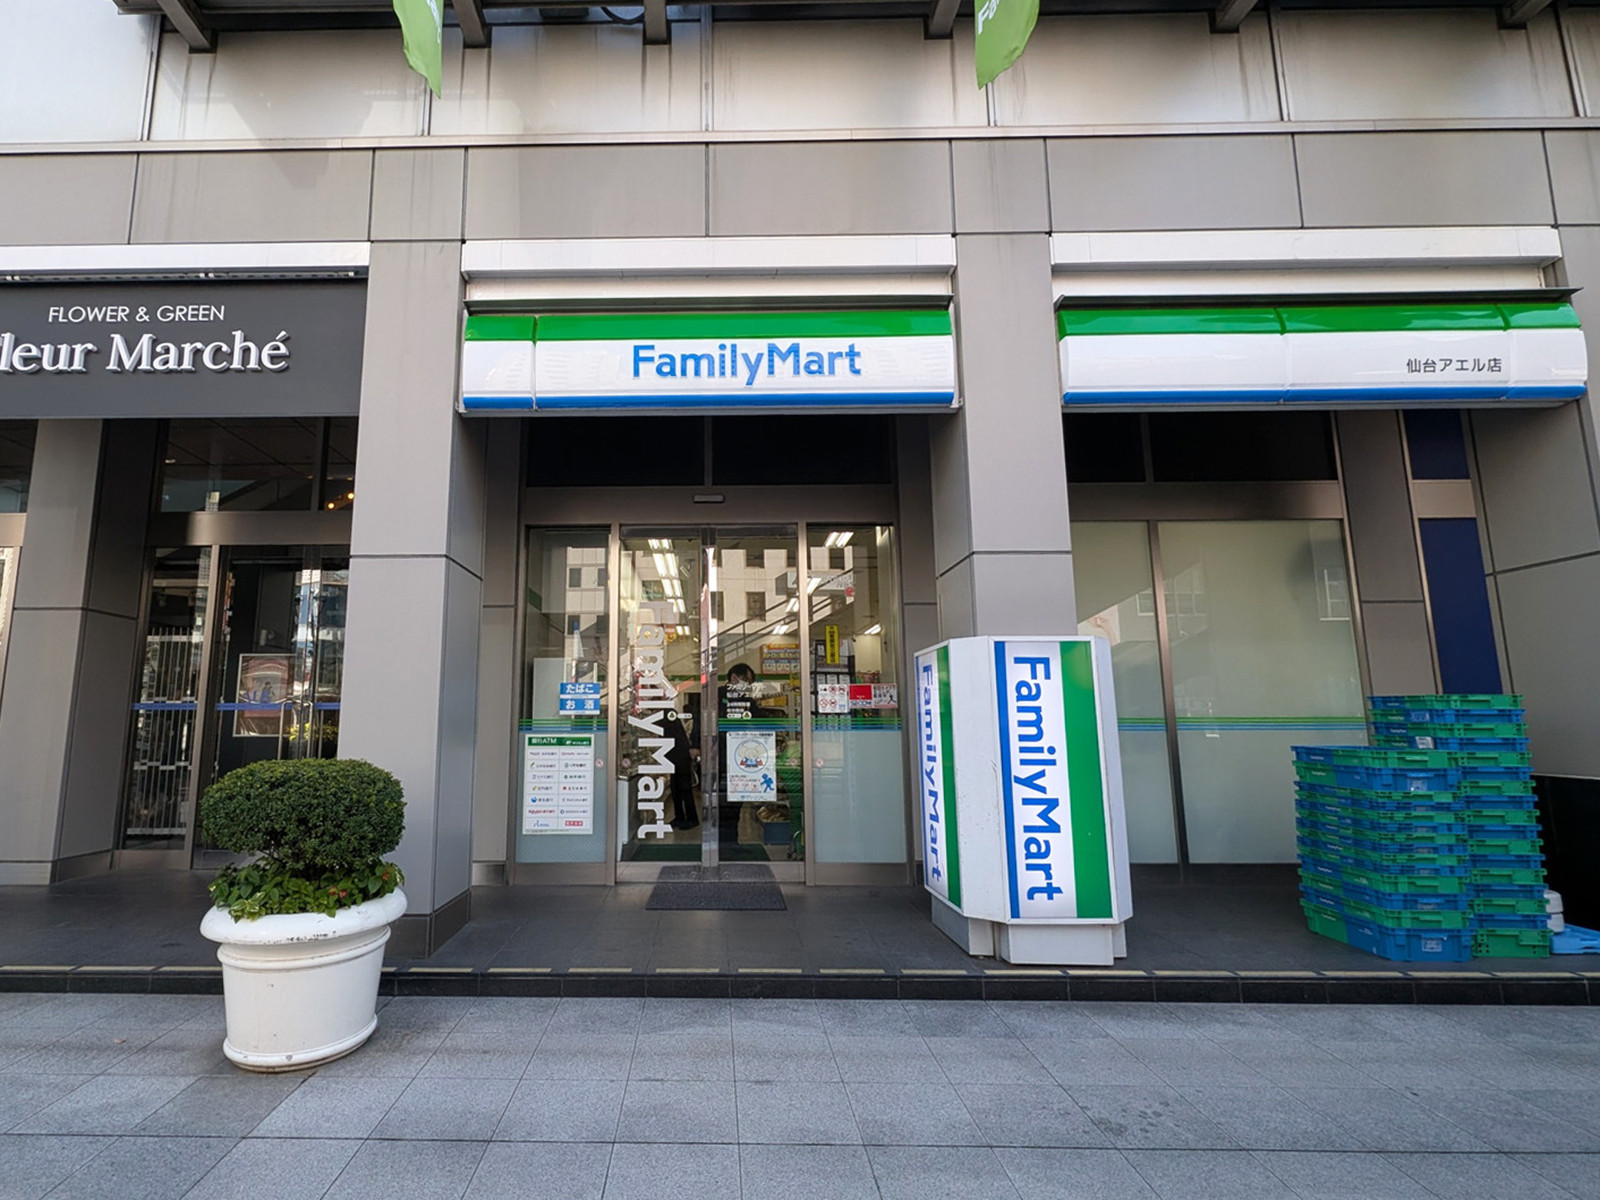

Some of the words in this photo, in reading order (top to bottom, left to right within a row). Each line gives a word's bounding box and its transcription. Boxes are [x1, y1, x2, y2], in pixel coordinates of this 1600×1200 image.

[48, 306, 130, 323] FLOWER
[136, 306, 151, 322] &
[156, 304, 226, 322] GREEN
[0, 331, 98, 373] leur
[105, 330, 291, 373] Marché
[632, 342, 862, 386] FamilyMart
[1406, 357, 1503, 374] 仙台アエル店
[565, 684, 594, 694] たばこ
[628, 602, 679, 839] FamilyMart
[922, 663, 942, 883] FamilyMart
[1013, 656, 1064, 901] FamilyMart
